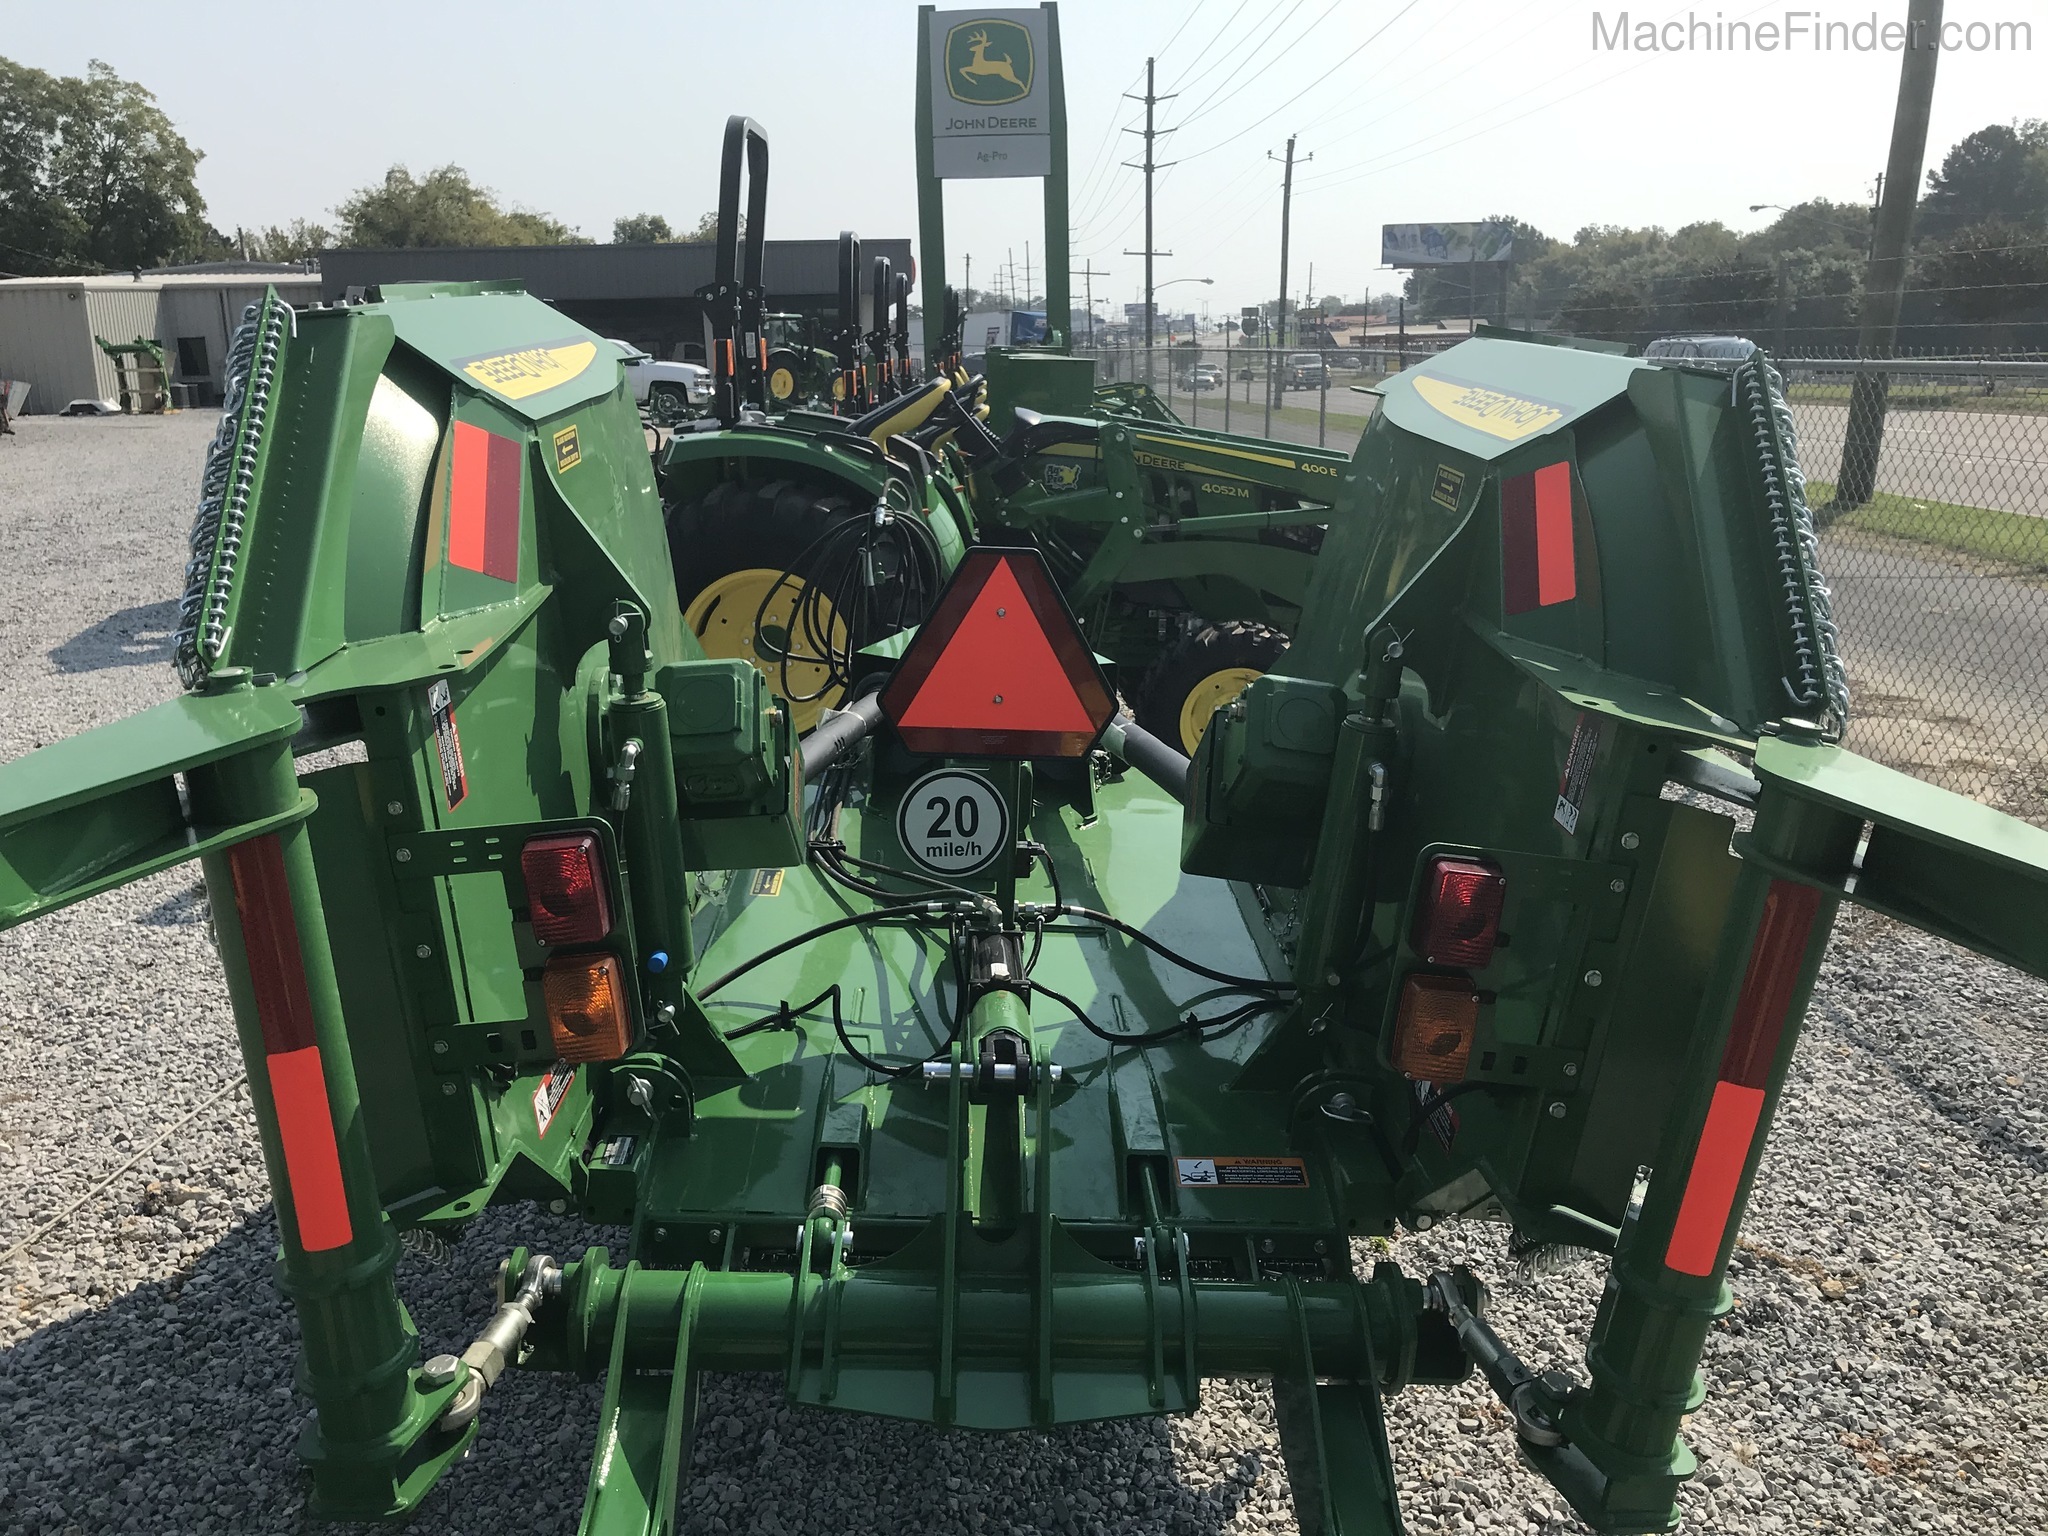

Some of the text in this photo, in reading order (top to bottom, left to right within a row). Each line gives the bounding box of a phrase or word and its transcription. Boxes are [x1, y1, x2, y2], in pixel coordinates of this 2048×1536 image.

[945, 116, 1037, 130] JOHN DEERE
[977, 151, 1008, 162] Ag-Pro
[1453, 390, 1511, 418] DEERE
[1143, 454, 1185, 470] DEERE
[1301, 463, 1338, 477] 400 E
[1567, 724, 1581, 766] DANGER
[454, 733, 465, 778] DANGER
[926, 795, 979, 838] 20
[926, 841, 982, 857] mile/h
